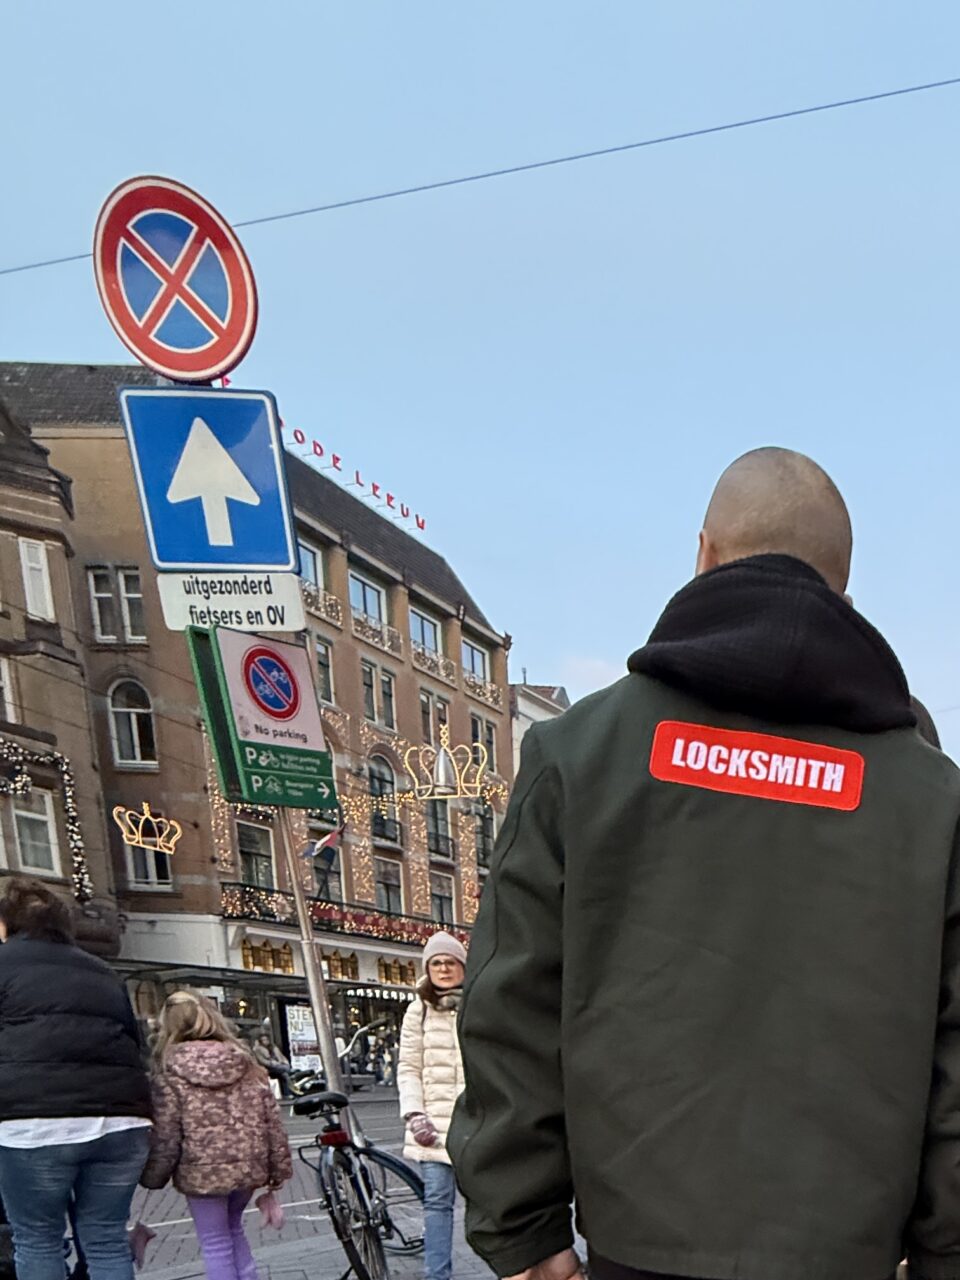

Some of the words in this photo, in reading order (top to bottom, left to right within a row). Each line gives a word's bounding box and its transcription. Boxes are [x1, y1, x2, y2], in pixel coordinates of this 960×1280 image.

[355, 470, 425, 530] LEEUW
[182, 575, 273, 600] uitgezonderd
[189, 605, 243, 625] fietsers
[246, 609, 264, 625] en
[266, 605, 285, 626] OV
[254, 724, 270, 736] No
[273, 728, 308, 744] parking
[245, 747, 257, 765] P
[671, 738, 845, 793] LOCKSMITH
[251, 775, 263, 792] P
[347, 988, 415, 1001] AMSTERDA
